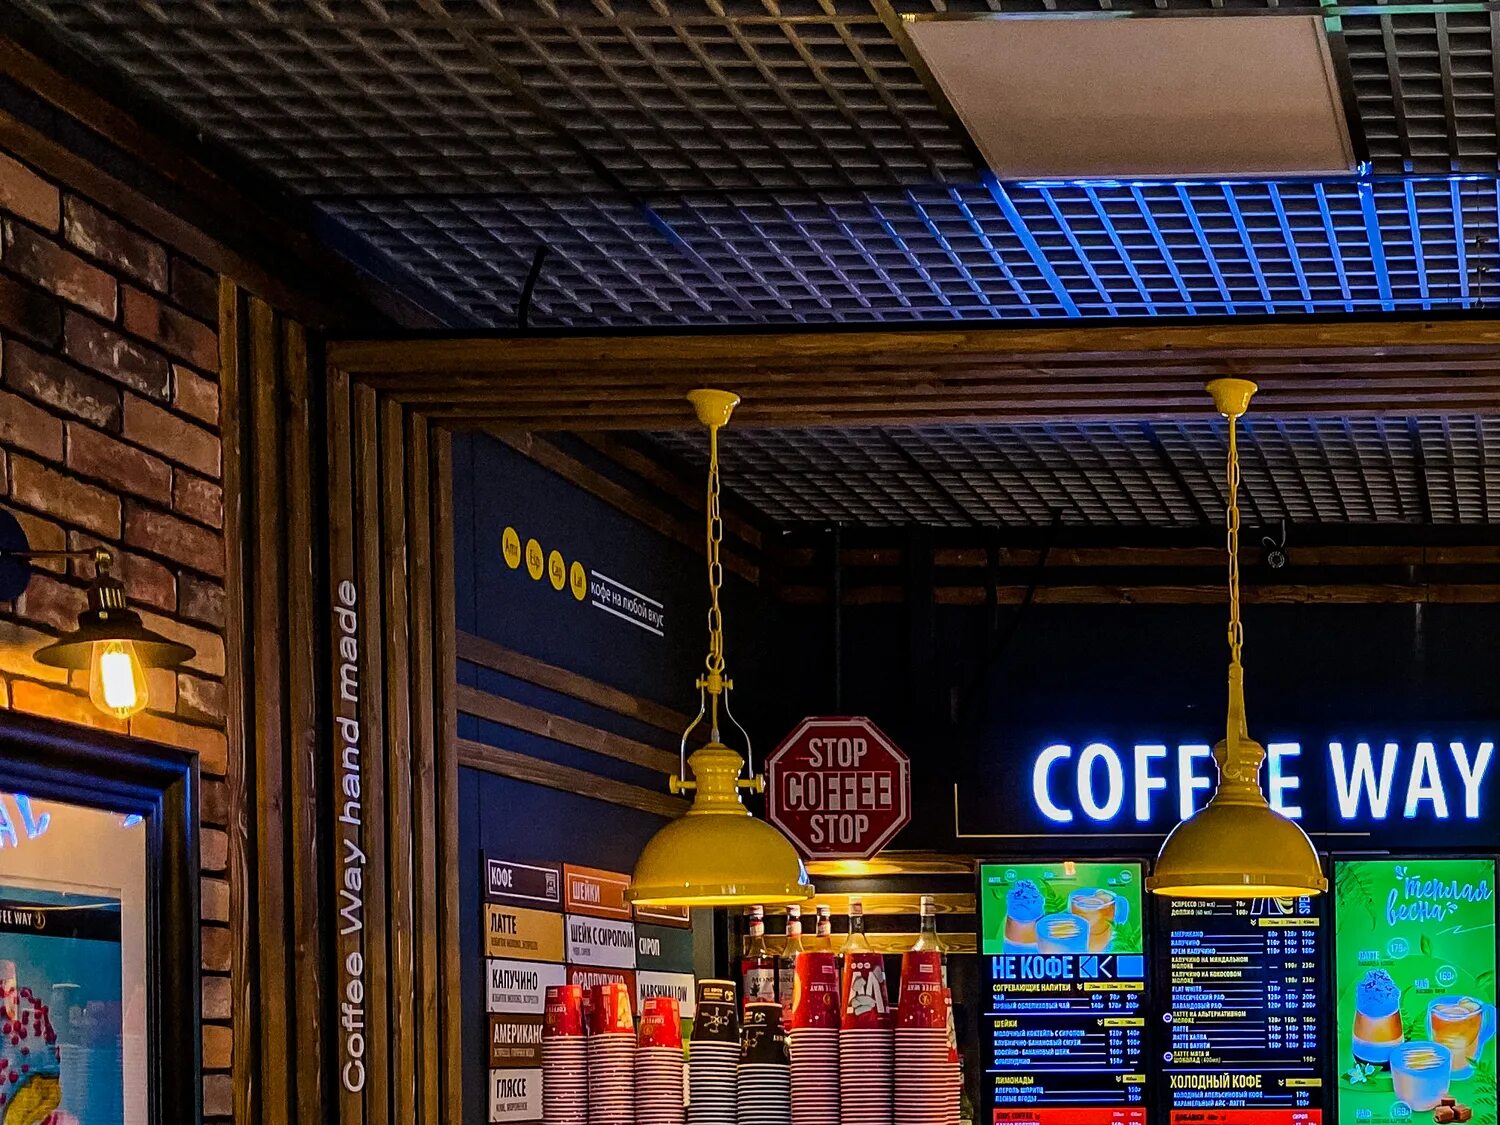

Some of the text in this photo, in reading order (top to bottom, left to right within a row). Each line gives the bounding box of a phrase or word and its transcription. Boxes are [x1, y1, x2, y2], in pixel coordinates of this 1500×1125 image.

[551, 560, 563, 582] Cap
[591, 581, 664, 628] кофе на любой вкус
[808, 738, 867, 767] STOP
[784, 771, 892, 810] COFFEE
[1032, 742, 1495, 822] COFFE WAY
[335, 578, 366, 1094] Coffee Way hand made
[810, 814, 869, 844] STOP
[491, 866, 513, 888] КОФЕ
[572, 880, 601, 903] ШЕЙКИ
[14, 912, 32, 926] WAY
[1385, 888, 1447, 927] весна
[490, 913, 518, 935] ЛАТТЕ
[570, 922, 634, 949] ШЕЙК С СИРОПОМ
[638, 936, 661, 957] СИРОП
[992, 955, 1074, 979] НЕ КОФЕ
[492, 968, 538, 991] КАПУЧИНО
[1040, 984, 1071, 992] НАПИТКИ
[994, 1019, 1018, 1028] ШЕЙКИ
[496, 1078, 527, 1099] ГЛЯССЕ
[995, 1077, 1034, 1085] ЛИМОНАДЫ
[1170, 1073, 1262, 1090] ХОЛОДНЫЙ КОФЕ
